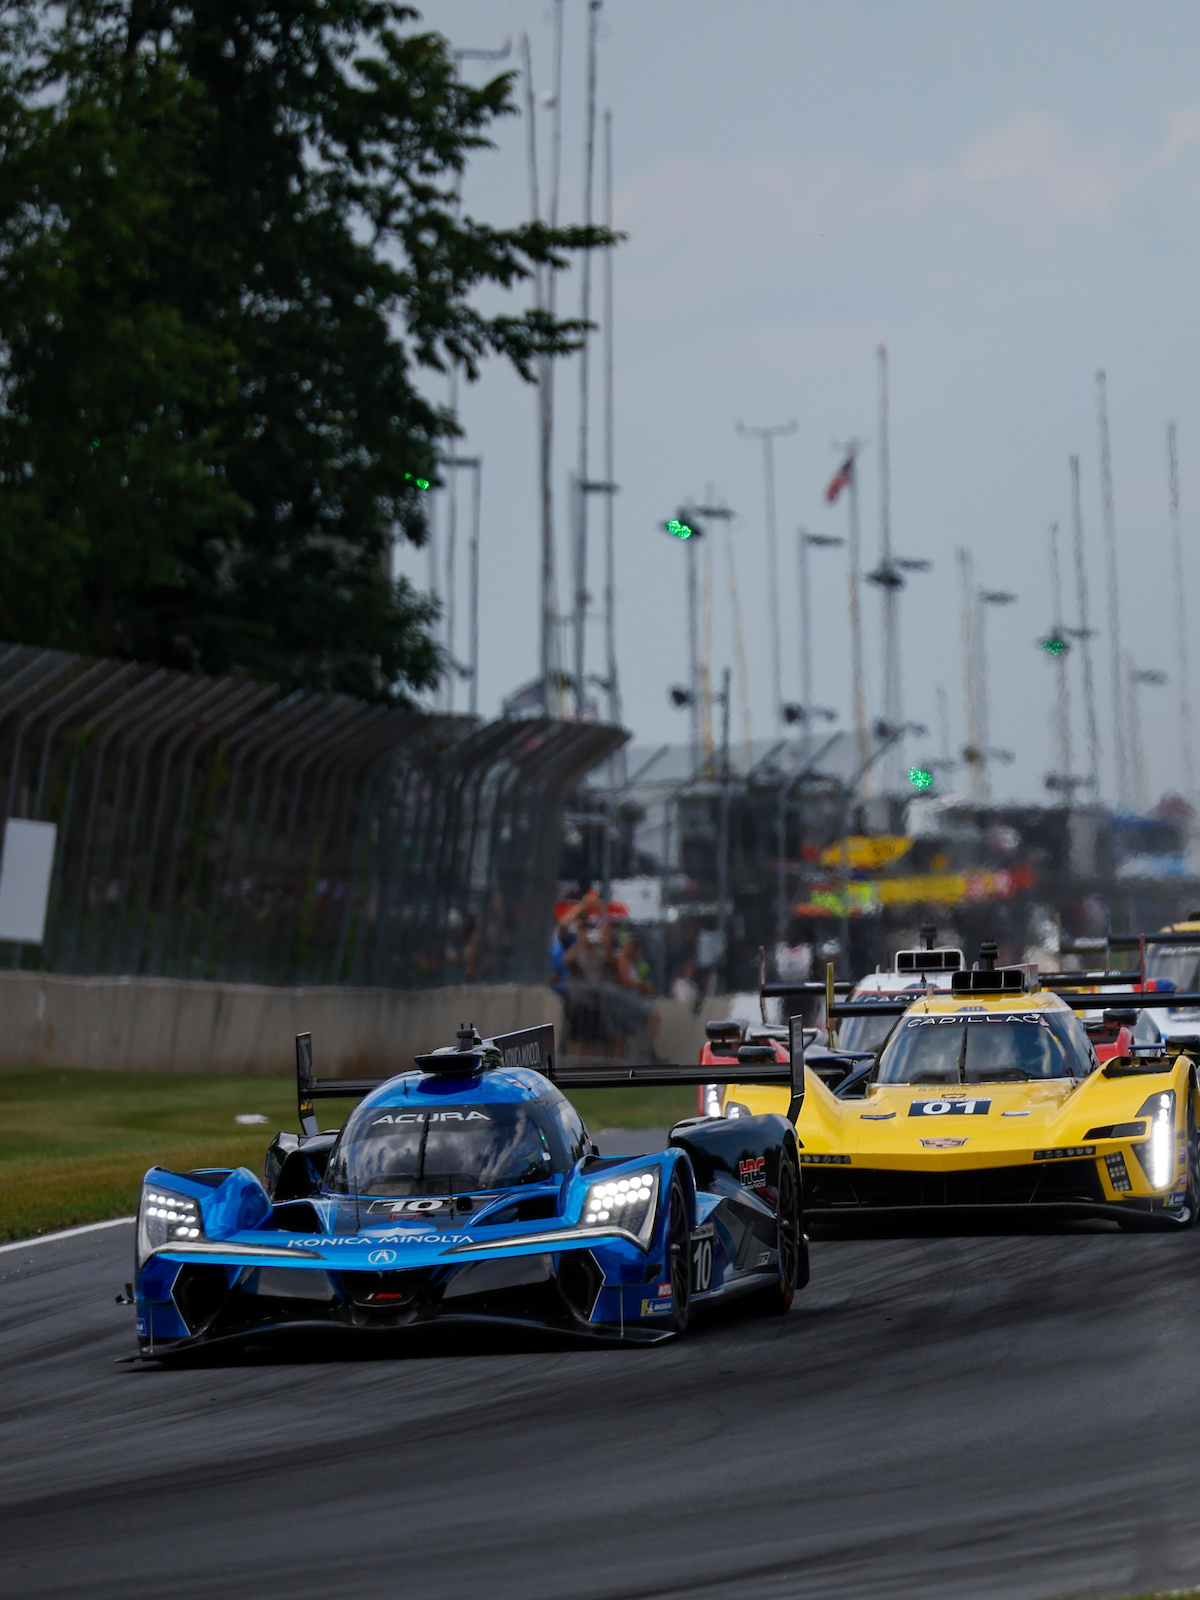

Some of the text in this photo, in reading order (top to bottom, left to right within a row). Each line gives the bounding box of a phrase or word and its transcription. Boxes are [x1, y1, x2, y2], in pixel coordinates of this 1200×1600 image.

[907, 1014, 1040, 1028] CADILLAC
[923, 1101, 977, 1115] 01
[371, 1110, 492, 1126] ACURA
[739, 1156, 766, 1187] HRC
[382, 1199, 444, 1213] 10
[286, 1234, 475, 1248] KONICA MINOLTA
[693, 1240, 712, 1292] 10
